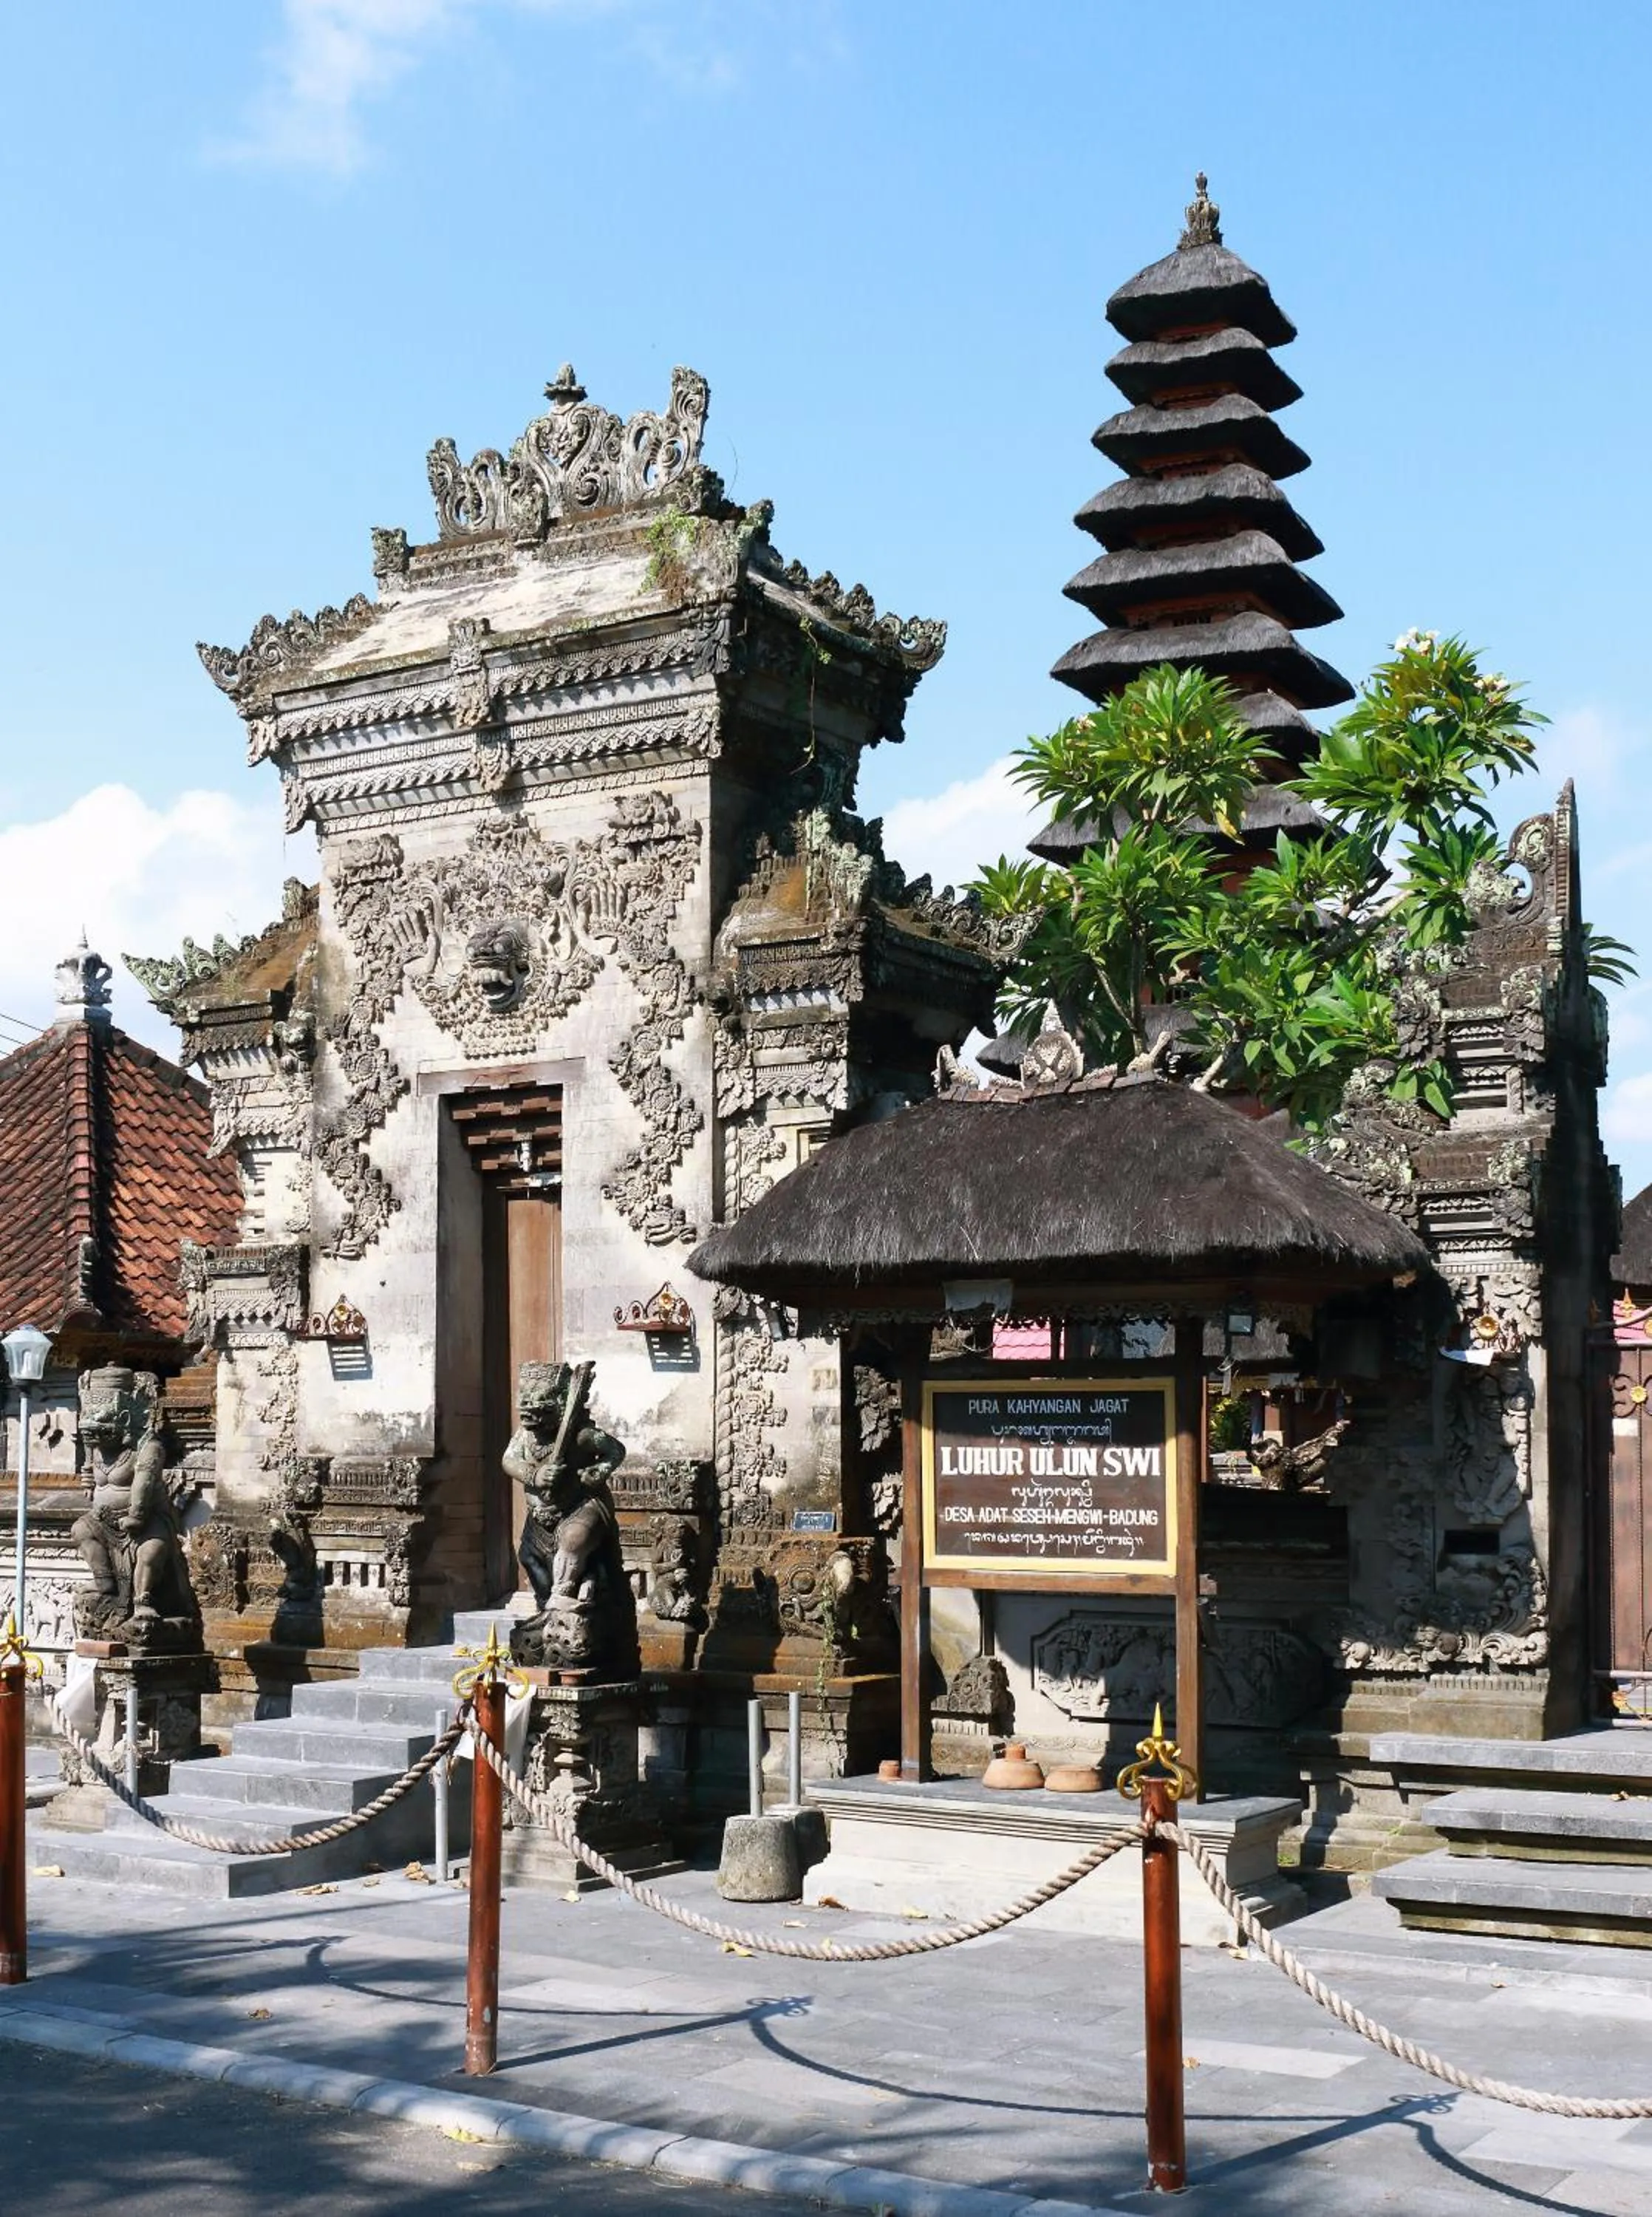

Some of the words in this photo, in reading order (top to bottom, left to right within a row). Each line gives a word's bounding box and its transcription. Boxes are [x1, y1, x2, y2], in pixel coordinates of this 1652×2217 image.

[969, 1399, 1000, 1414] PURA
[1007, 1399, 1081, 1414] KAHYANGAN
[1090, 1398, 1130, 1414] JAGAT
[941, 1446, 1024, 1477] LUHUR
[1029, 1446, 1098, 1477] ULUN
[1103, 1447, 1160, 1477] SWI
[945, 1507, 975, 1523] DESA
[979, 1507, 1008, 1523] ADAT
